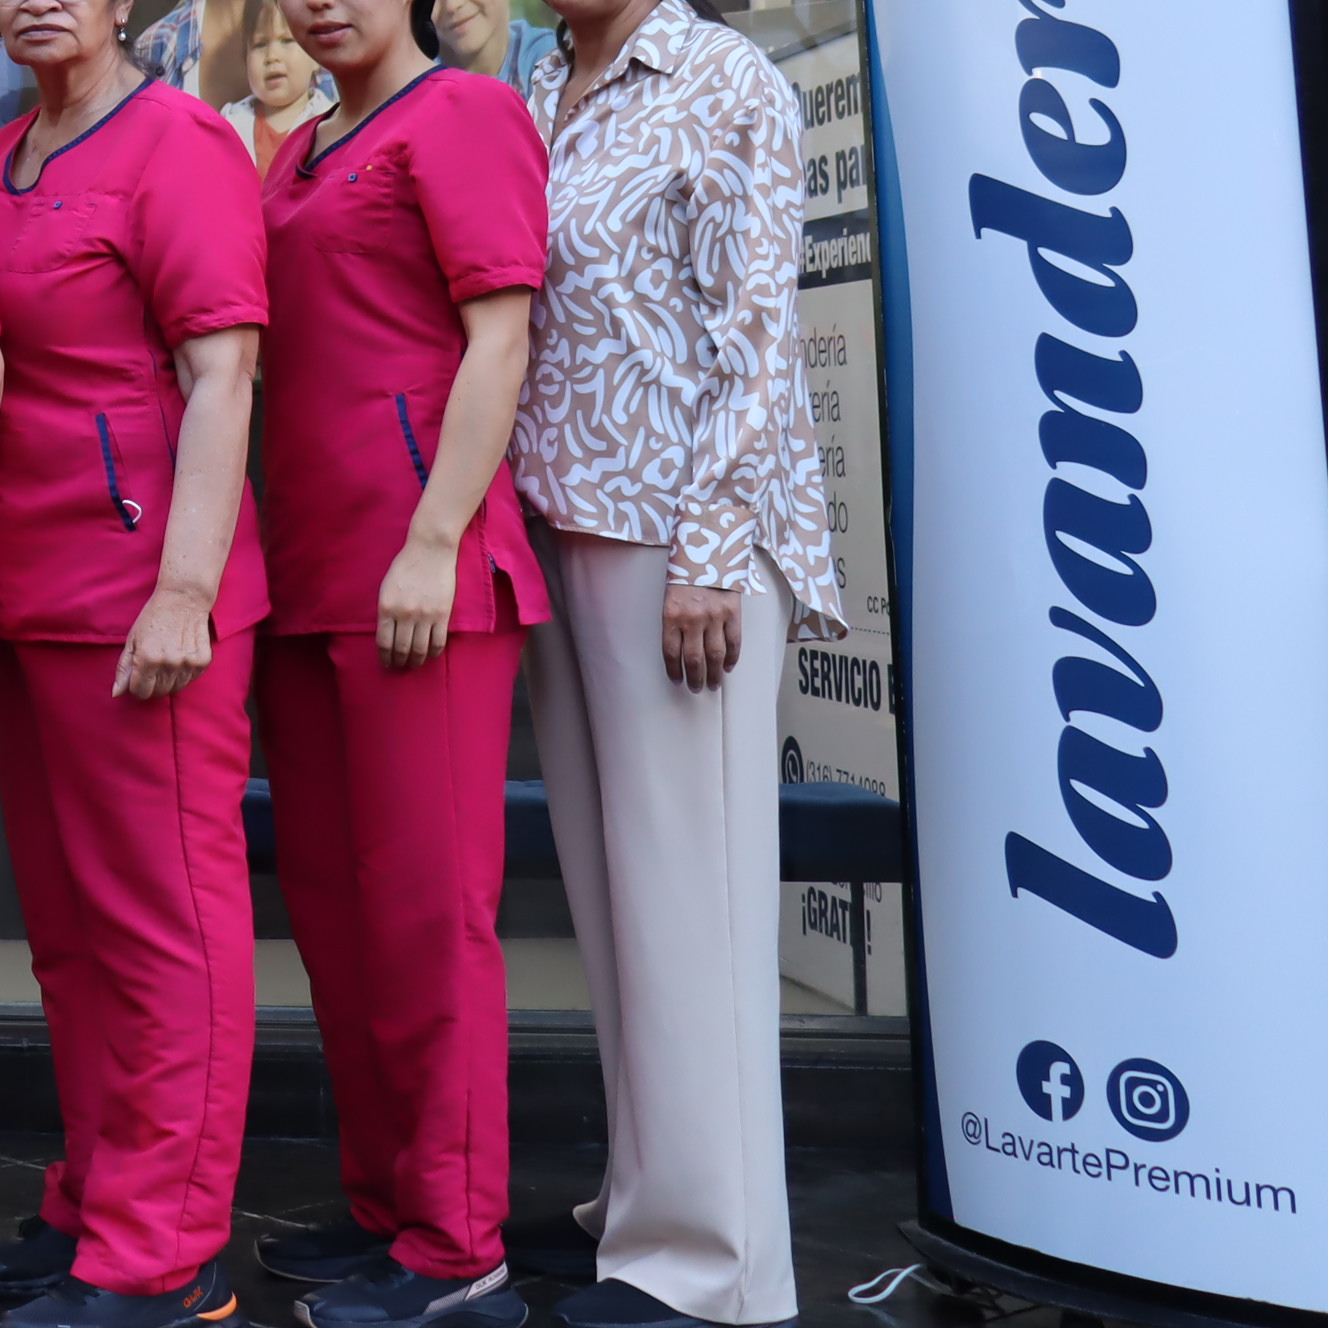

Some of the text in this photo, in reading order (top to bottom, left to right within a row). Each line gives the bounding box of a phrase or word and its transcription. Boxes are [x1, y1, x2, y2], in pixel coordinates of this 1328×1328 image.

[800, 324, 848, 369] ndería
[798, 647, 882, 711] SERVICIO
[960, 1111, 1298, 1215] @LavartePremium
